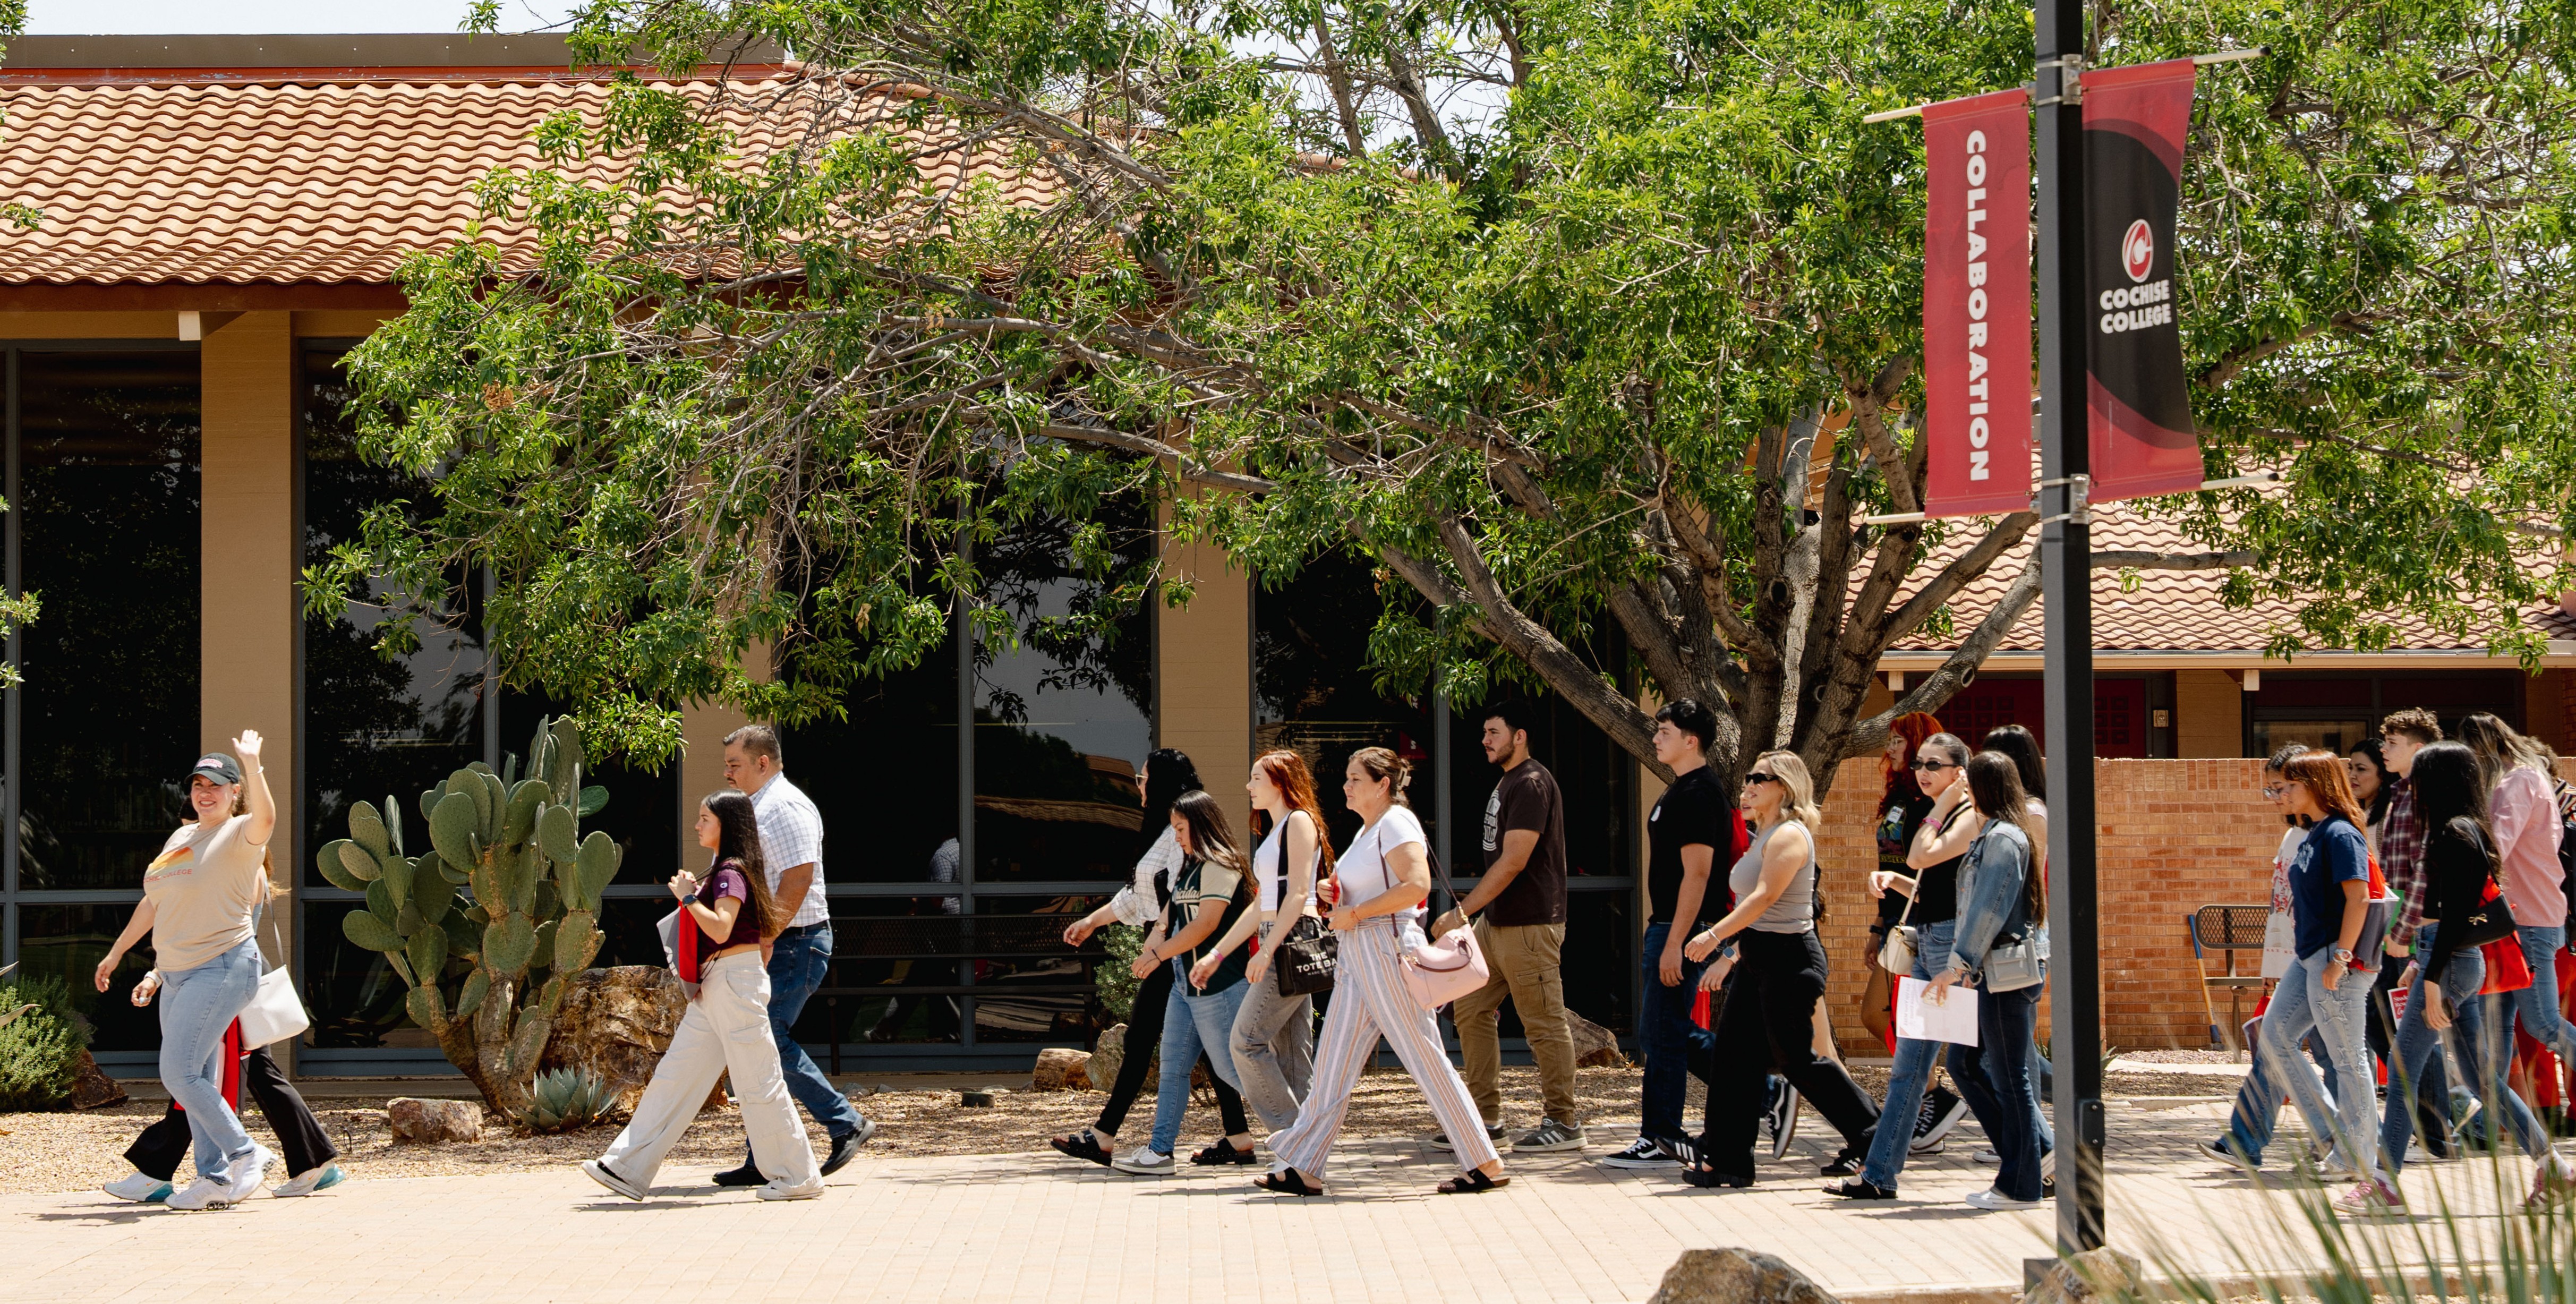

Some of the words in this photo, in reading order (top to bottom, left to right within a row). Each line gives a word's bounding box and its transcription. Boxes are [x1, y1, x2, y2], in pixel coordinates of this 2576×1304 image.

[1966, 130, 1990, 481] COLLABORATION
[2100, 279, 2170, 310] COCHISE
[2100, 303, 2172, 334] COLLEGE
[1296, 961, 1323, 973] TOTE
[1309, 952, 1328, 961] THE
